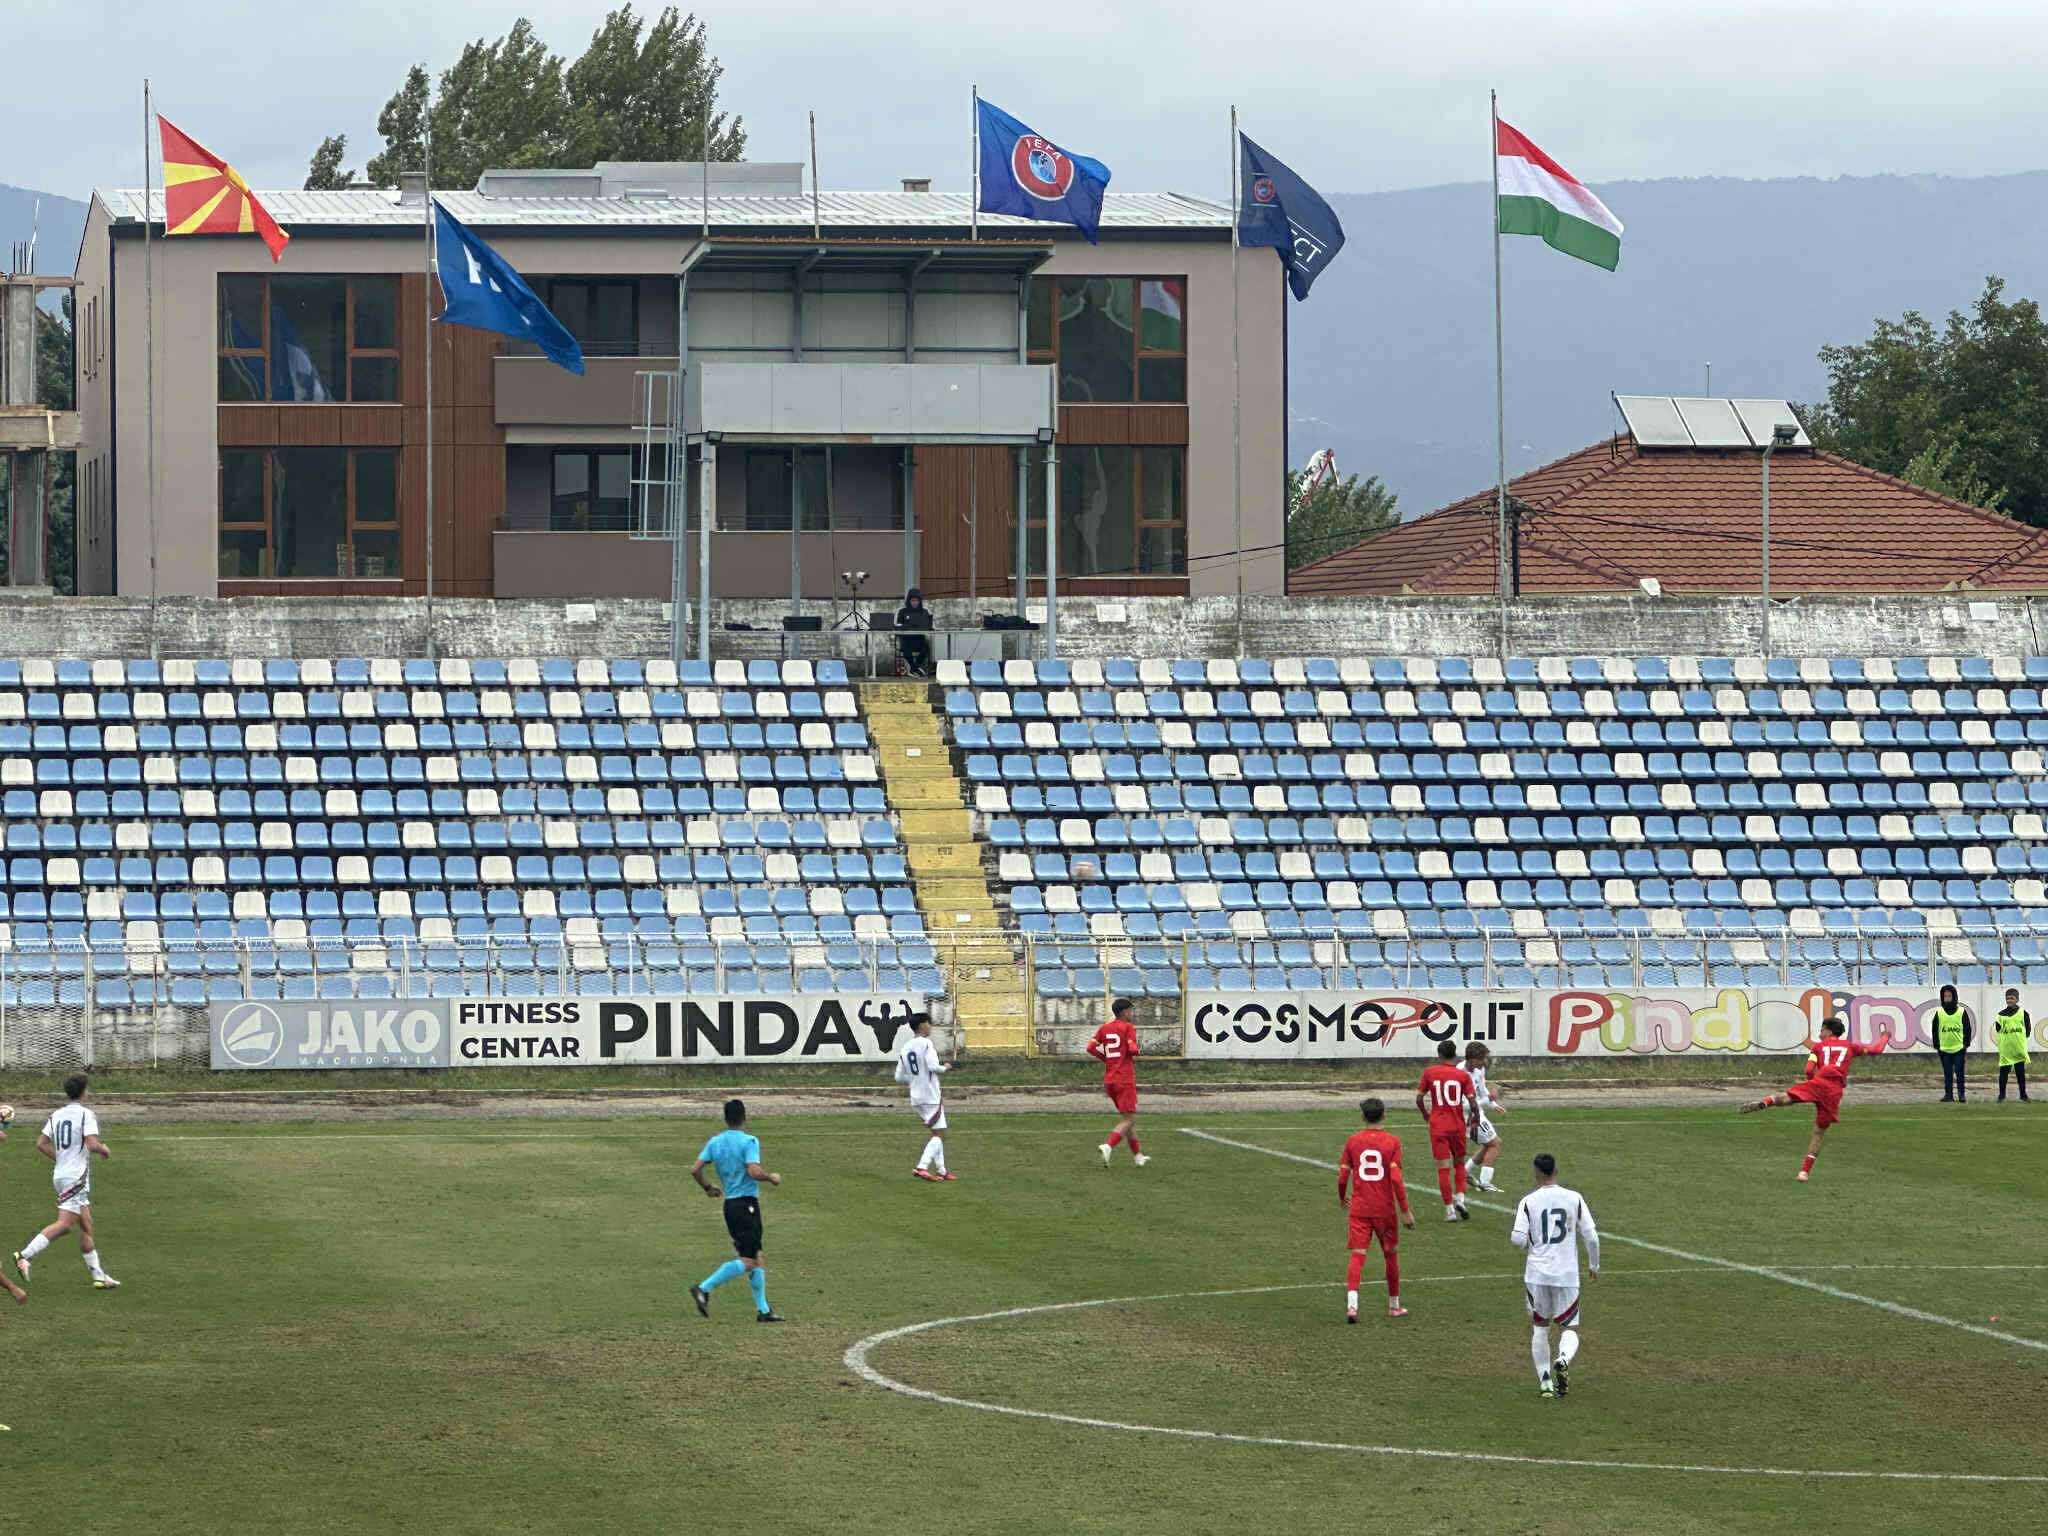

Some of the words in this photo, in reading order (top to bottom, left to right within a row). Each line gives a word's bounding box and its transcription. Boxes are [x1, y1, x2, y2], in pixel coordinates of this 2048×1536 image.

[460, 1003, 580, 1024] FITNESS
[299, 1010, 441, 1054] JAKO
[460, 1037, 580, 1059] CENTAR
[1105, 1033, 1121, 1058] 2
[1822, 1046, 1848, 1067] 17
[299, 1056, 437, 1066] MACEDONIA
[907, 1051, 920, 1076] 8
[1432, 1080, 1461, 1107] 10
[56, 1119, 73, 1151] 10
[1358, 1149, 1384, 1182] 8
[1541, 1208, 1568, 1244] 13
